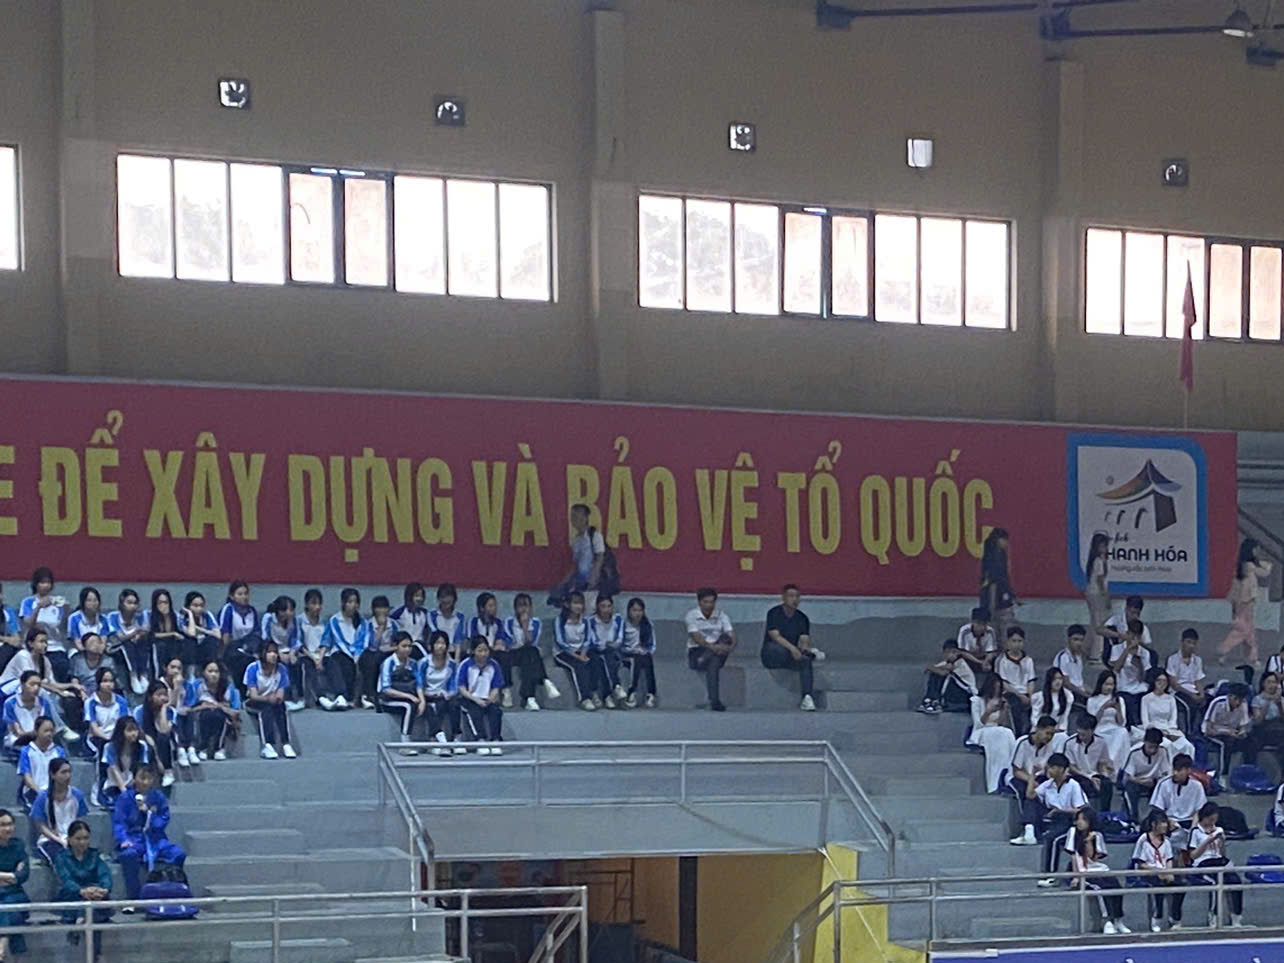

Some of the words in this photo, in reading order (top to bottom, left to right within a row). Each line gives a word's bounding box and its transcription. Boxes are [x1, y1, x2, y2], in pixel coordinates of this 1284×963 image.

[38, 409, 123, 537] ĐỂ
[143, 431, 266, 540] XÂY
[288, 447, 454, 562] DỰNG
[472, 443, 549, 546] VÀ
[567, 436, 678, 550] BẢO
[695, 452, 761, 571] VỆ
[777, 440, 841, 554] TỔ
[860, 449, 995, 565] QUỐC
[1107, 547, 1149, 561] HANH
[1154, 545, 1187, 562] HÓA
